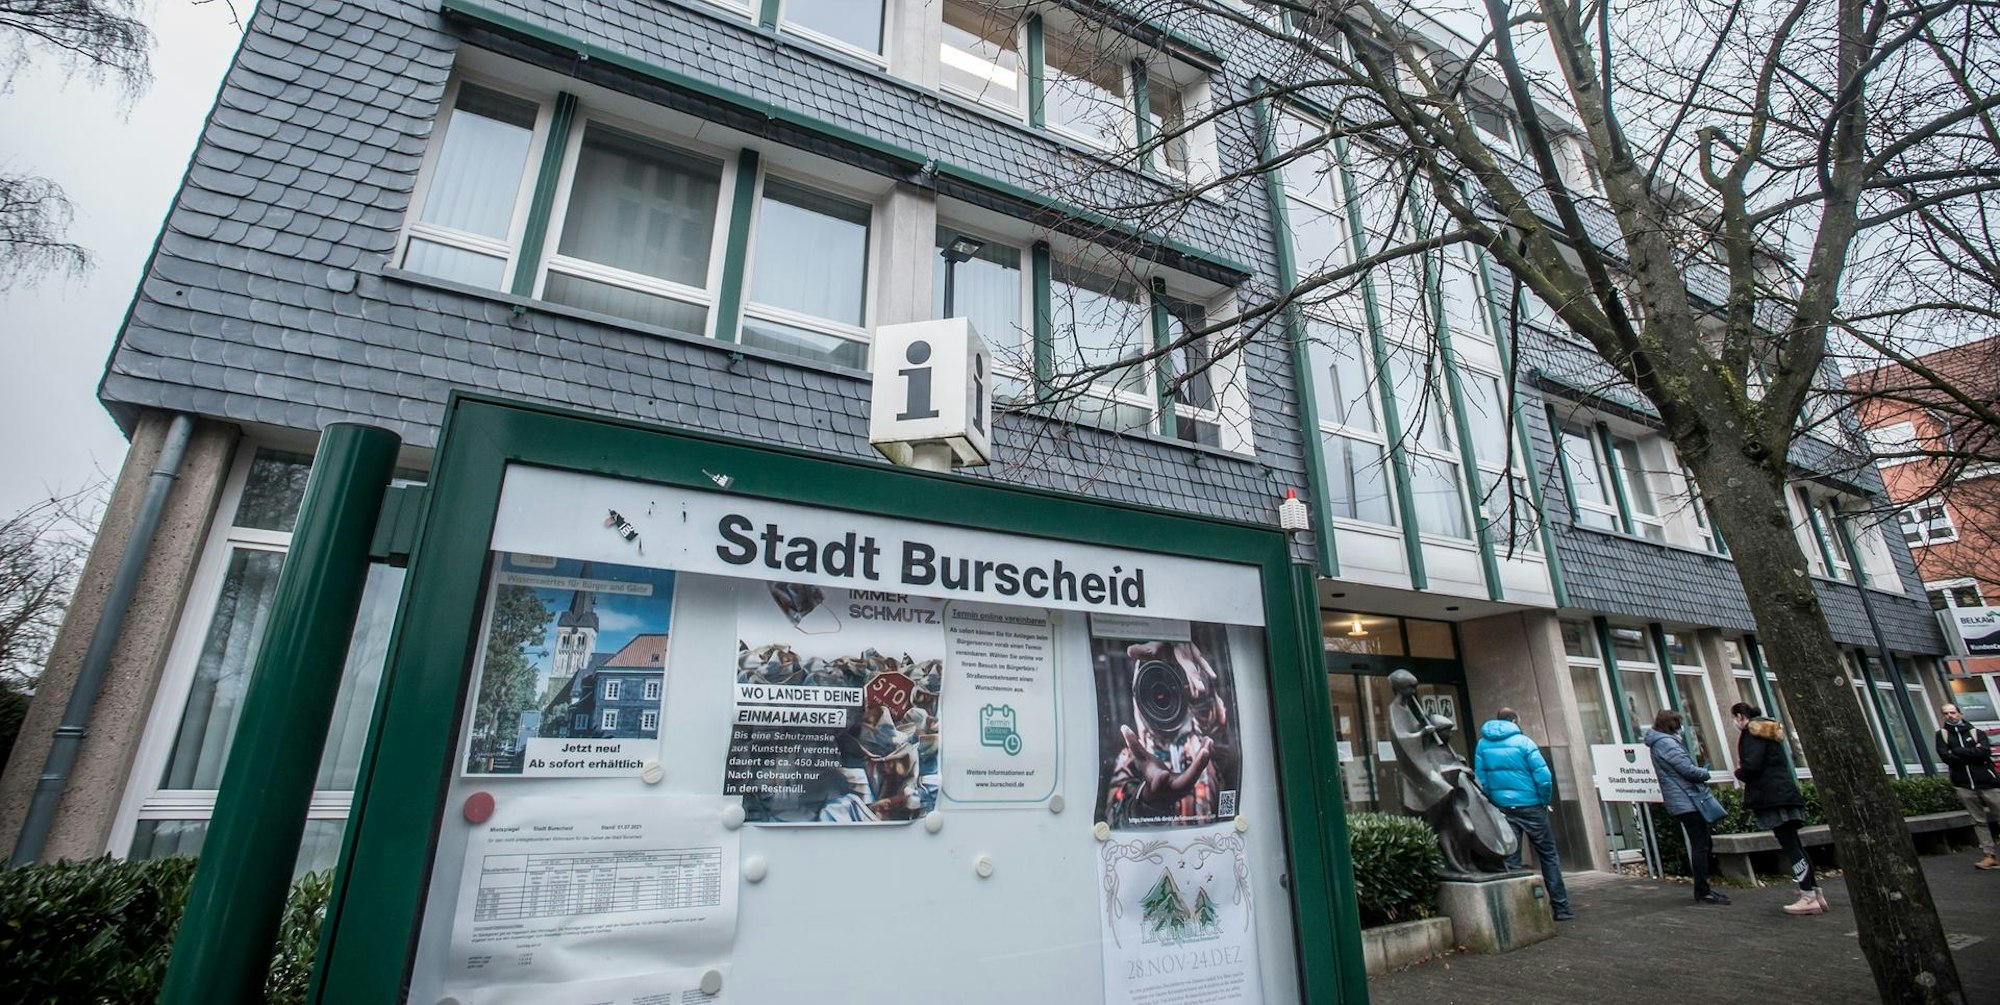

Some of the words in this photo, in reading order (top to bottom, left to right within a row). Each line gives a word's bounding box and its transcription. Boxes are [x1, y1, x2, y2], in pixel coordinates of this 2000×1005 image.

[716, 514, 880, 581] Stadt
[901, 540, 1147, 608] Burscheid
[507, 573, 566, 587] Wissenswertes
[582, 580, 608, 591] Bürger
[610, 583, 625, 591] und
[849, 589, 908, 603] IMMER
[849, 604, 941, 624] SCHMUTZ.
[952, 608, 978, 619] Termin
[980, 612, 1003, 620] online
[1004, 614, 1046, 626] vereinbaren
[1960, 616, 1995, 625] BELKAW
[741, 687, 764, 699] WO
[768, 688, 820, 701] LANDET
[824, 690, 860, 703] DEINE
[738, 710, 844, 725] EINMALMASKE?
[986, 718, 1010, 726] Termin
[734, 731, 748, 740] Bis
[751, 732, 771, 740] eine
[774, 732, 835, 742] Schutzmaske
[561, 744, 592, 753] Jetzt
[595, 744, 621, 753] neu!
[751, 744, 801, 753] Kunststoff
[803, 746, 842, 756] verottet,
[528, 759, 545, 768] Ab
[549, 759, 585, 768] sofort
[588, 759, 645, 768] erhältlich
[729, 757, 761, 766] dauert
[794, 758, 812, 767] 450
[814, 758, 842, 767] Jahre.
[728, 770, 753, 779] Nach
[756, 771, 802, 780] Gebrauch
[1608, 776, 1627, 784] Stadt
[726, 784, 736, 792] in
[739, 784, 758, 793] den
[761, 784, 806, 793] Restmüll.
[1792, 857, 1808, 875] NIKE
